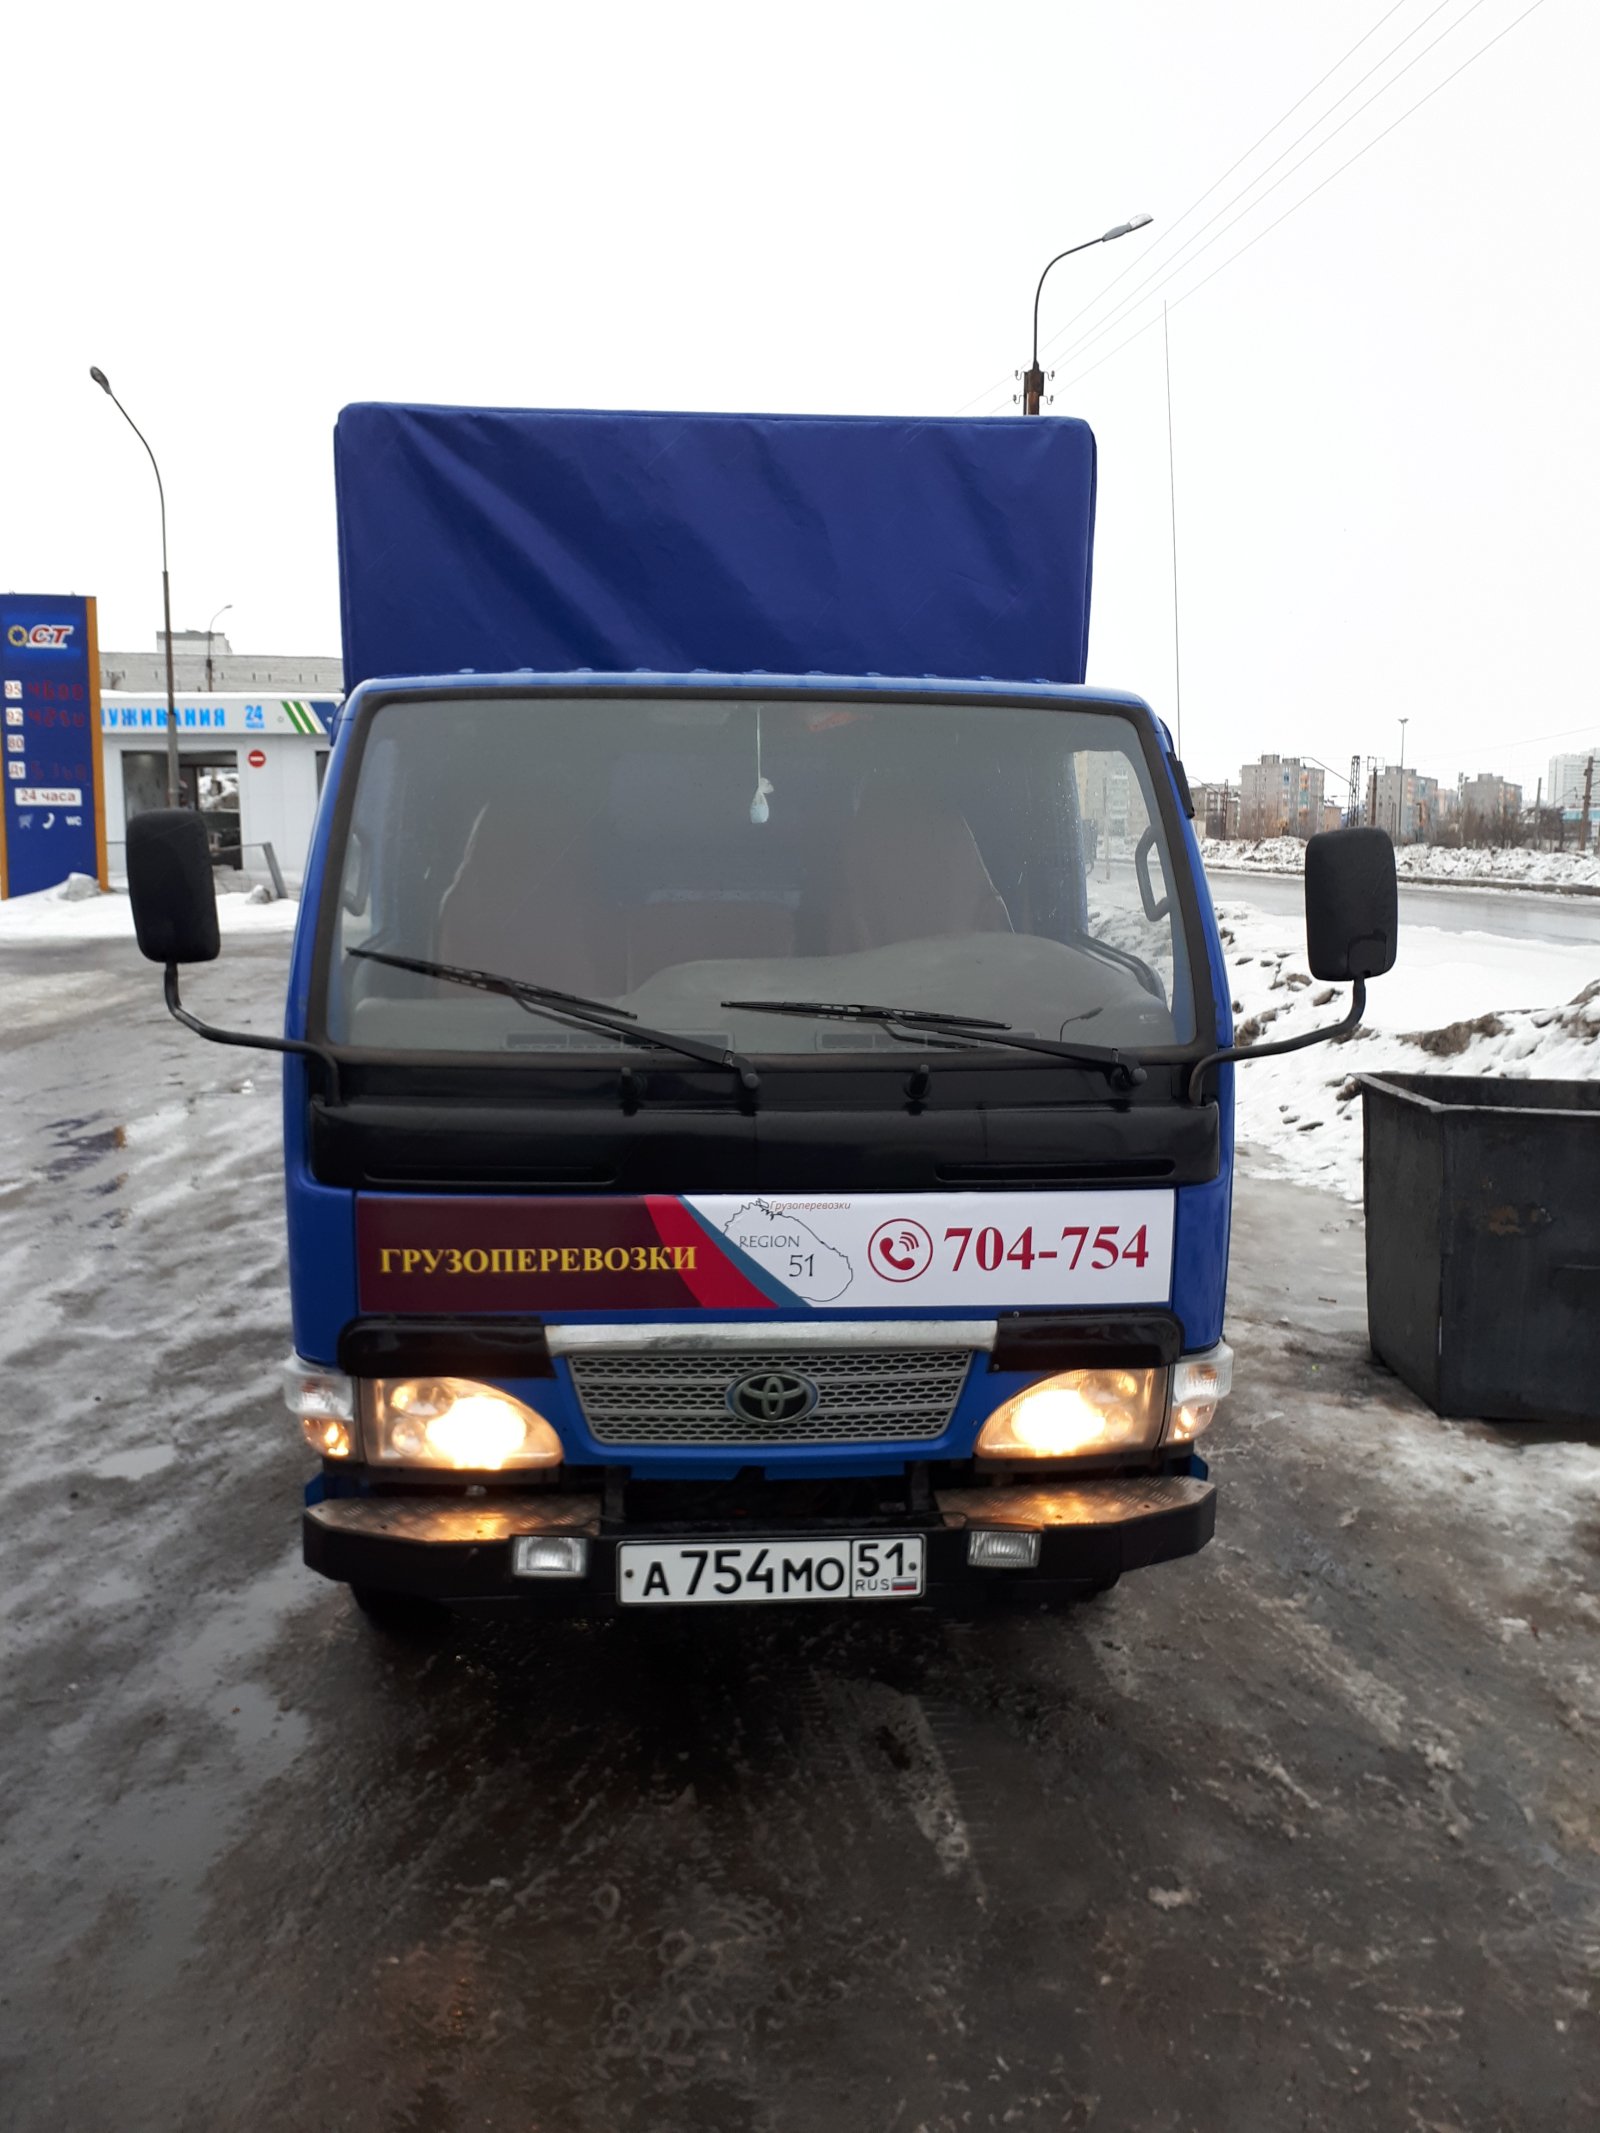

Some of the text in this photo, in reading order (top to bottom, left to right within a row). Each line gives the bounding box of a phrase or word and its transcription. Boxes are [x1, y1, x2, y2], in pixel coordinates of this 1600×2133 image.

[5, 683, 21, 697] 95
[7, 709, 23, 724] 92
[245, 704, 263, 720] 24
[21, 789, 76, 802] 24 часа
[770, 1199, 851, 1213] Грузоперевозки
[739, 1234, 801, 1248] REGION
[944, 1224, 1150, 1273] 704-754
[380, 1245, 698, 1274] ГРУЗОПЕРЕВОЗКИ
[789, 1253, 816, 1278] 51
[857, 1542, 905, 1577] 51
[855, 1578, 890, 1592] RUS
